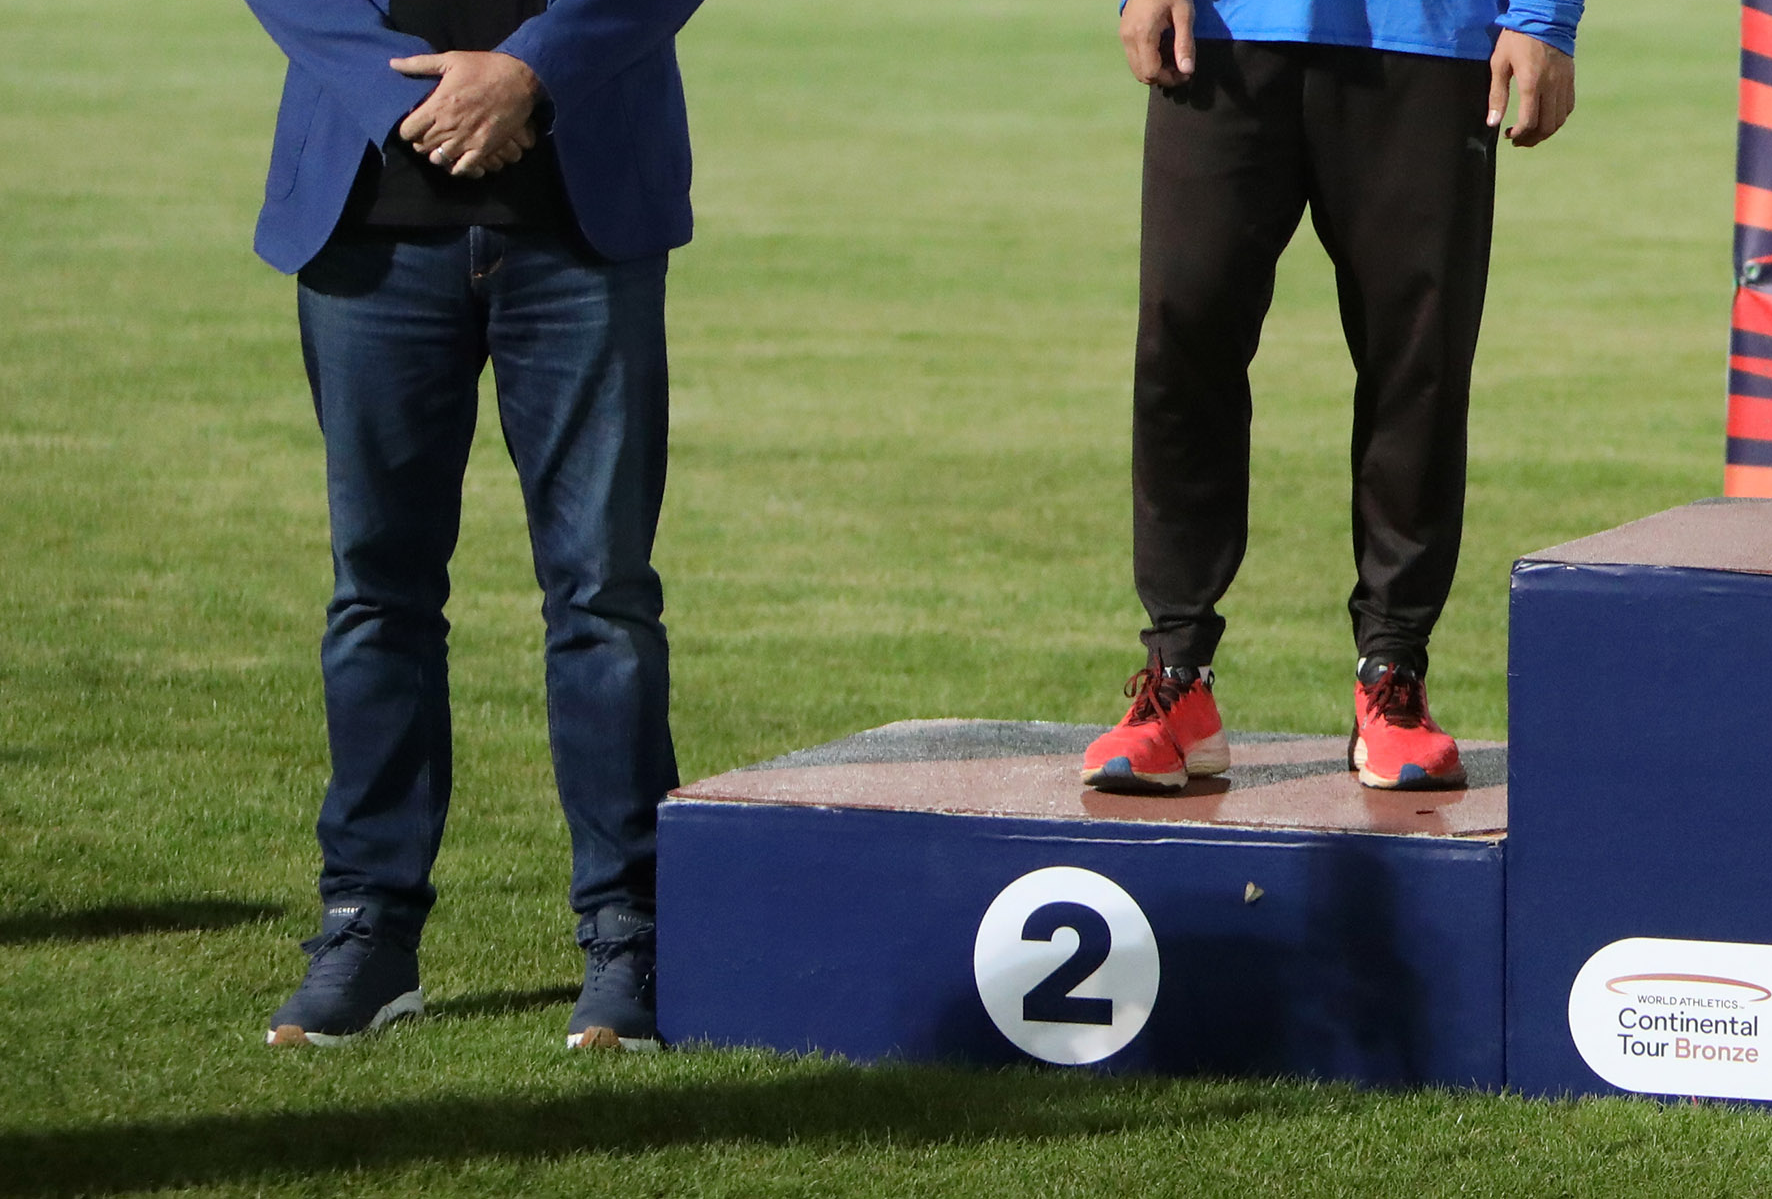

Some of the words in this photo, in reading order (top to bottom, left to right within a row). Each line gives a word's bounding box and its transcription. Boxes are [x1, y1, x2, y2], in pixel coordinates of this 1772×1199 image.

[1020, 900, 1114, 1025] 2
[1637, 994, 1678, 1006] WORLD
[1618, 1007, 1759, 1037] Continental
[1616, 1033, 1669, 1058] Tour
[1675, 1037, 1760, 1063] Bronze
